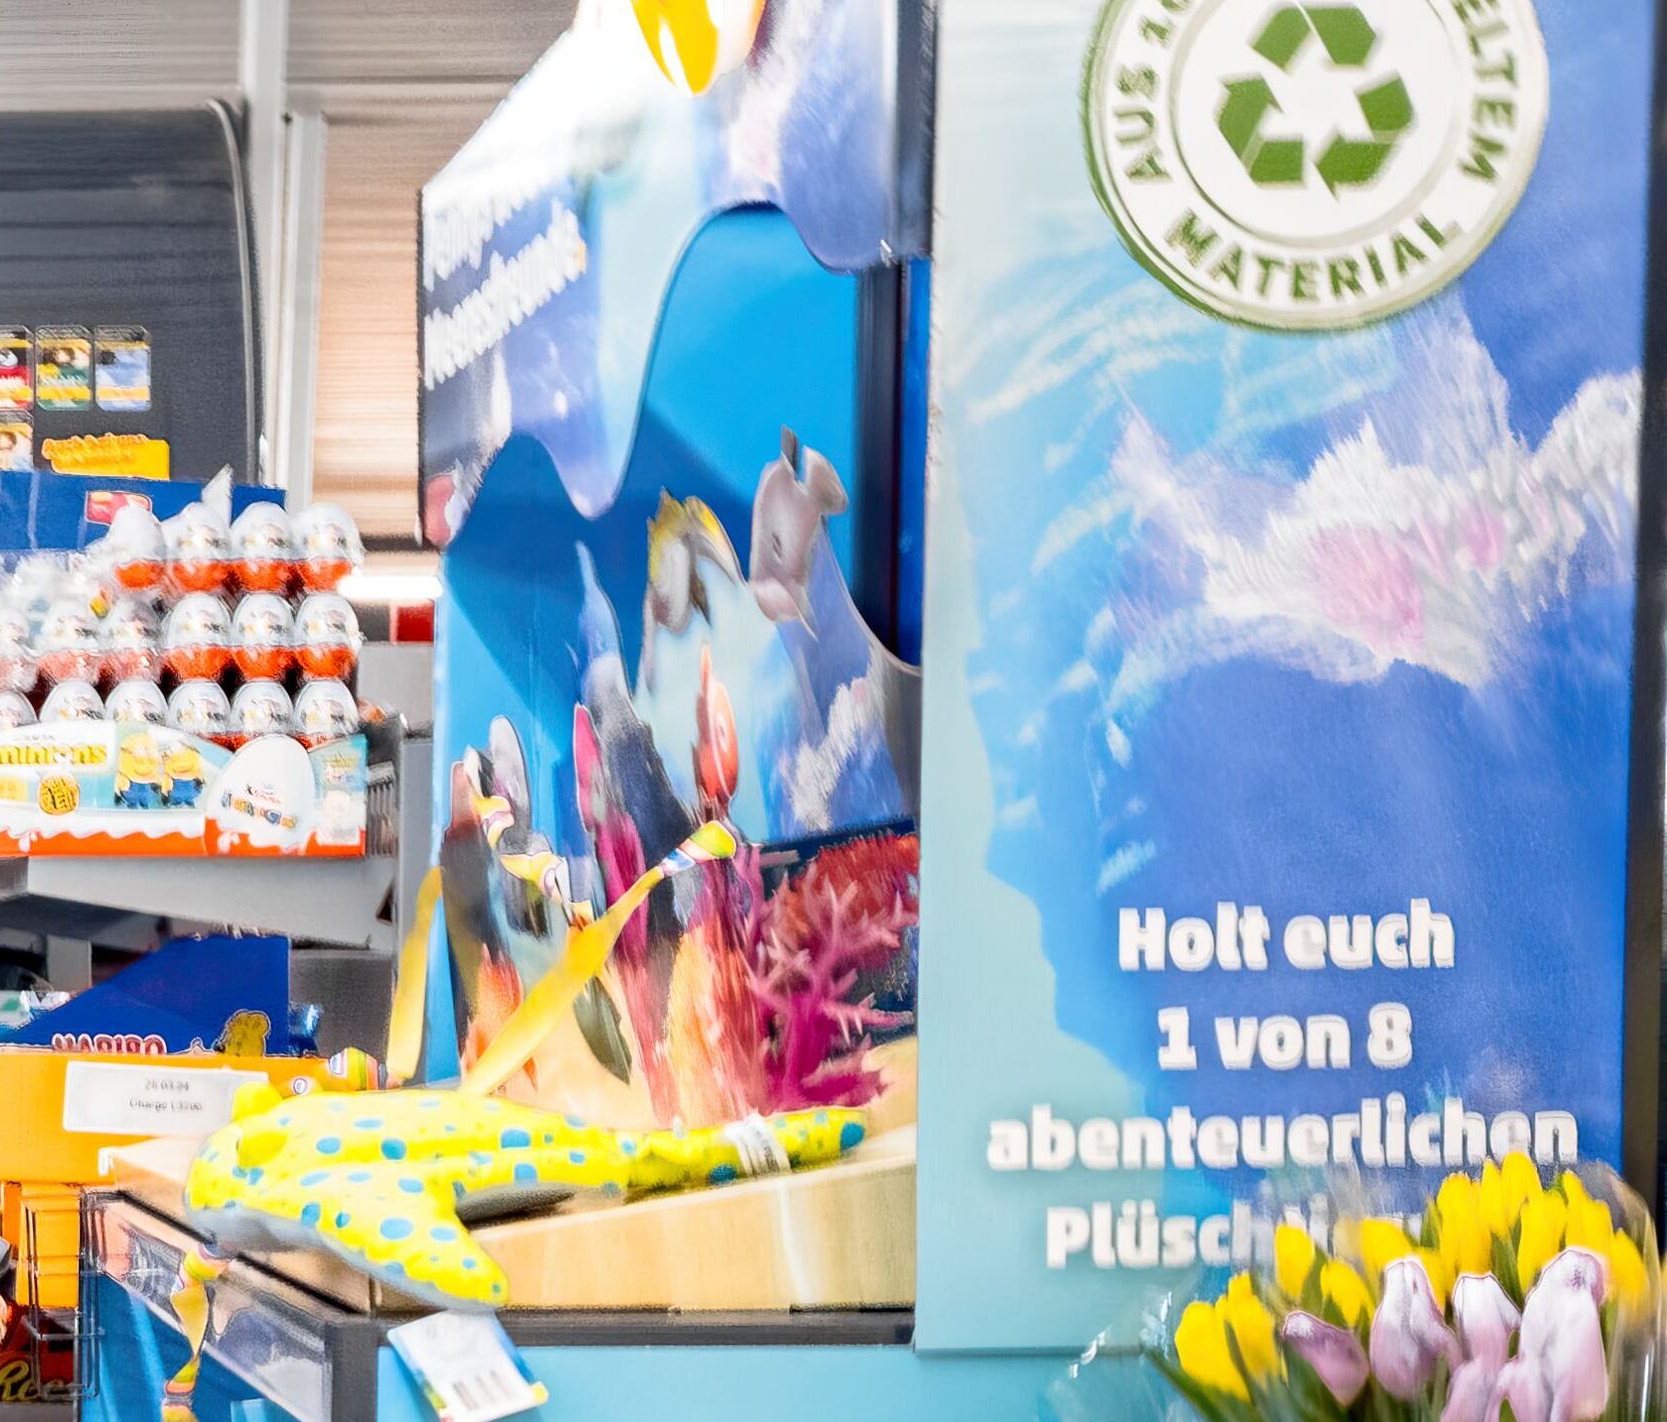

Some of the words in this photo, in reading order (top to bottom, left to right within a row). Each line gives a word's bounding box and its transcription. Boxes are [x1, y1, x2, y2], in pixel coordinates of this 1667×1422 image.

[1114, 62, 1173, 184] AUS
[1163, 206, 1465, 303] MATERIAL
[1118, 900, 1270, 972] Holt
[1283, 897, 1455, 970] euch
[1157, 1006, 1198, 1071] 1
[1214, 1013, 1351, 1071] von
[1367, 1002, 1414, 1069] 8
[986, 1089, 1579, 1171] abenteuerlichen
